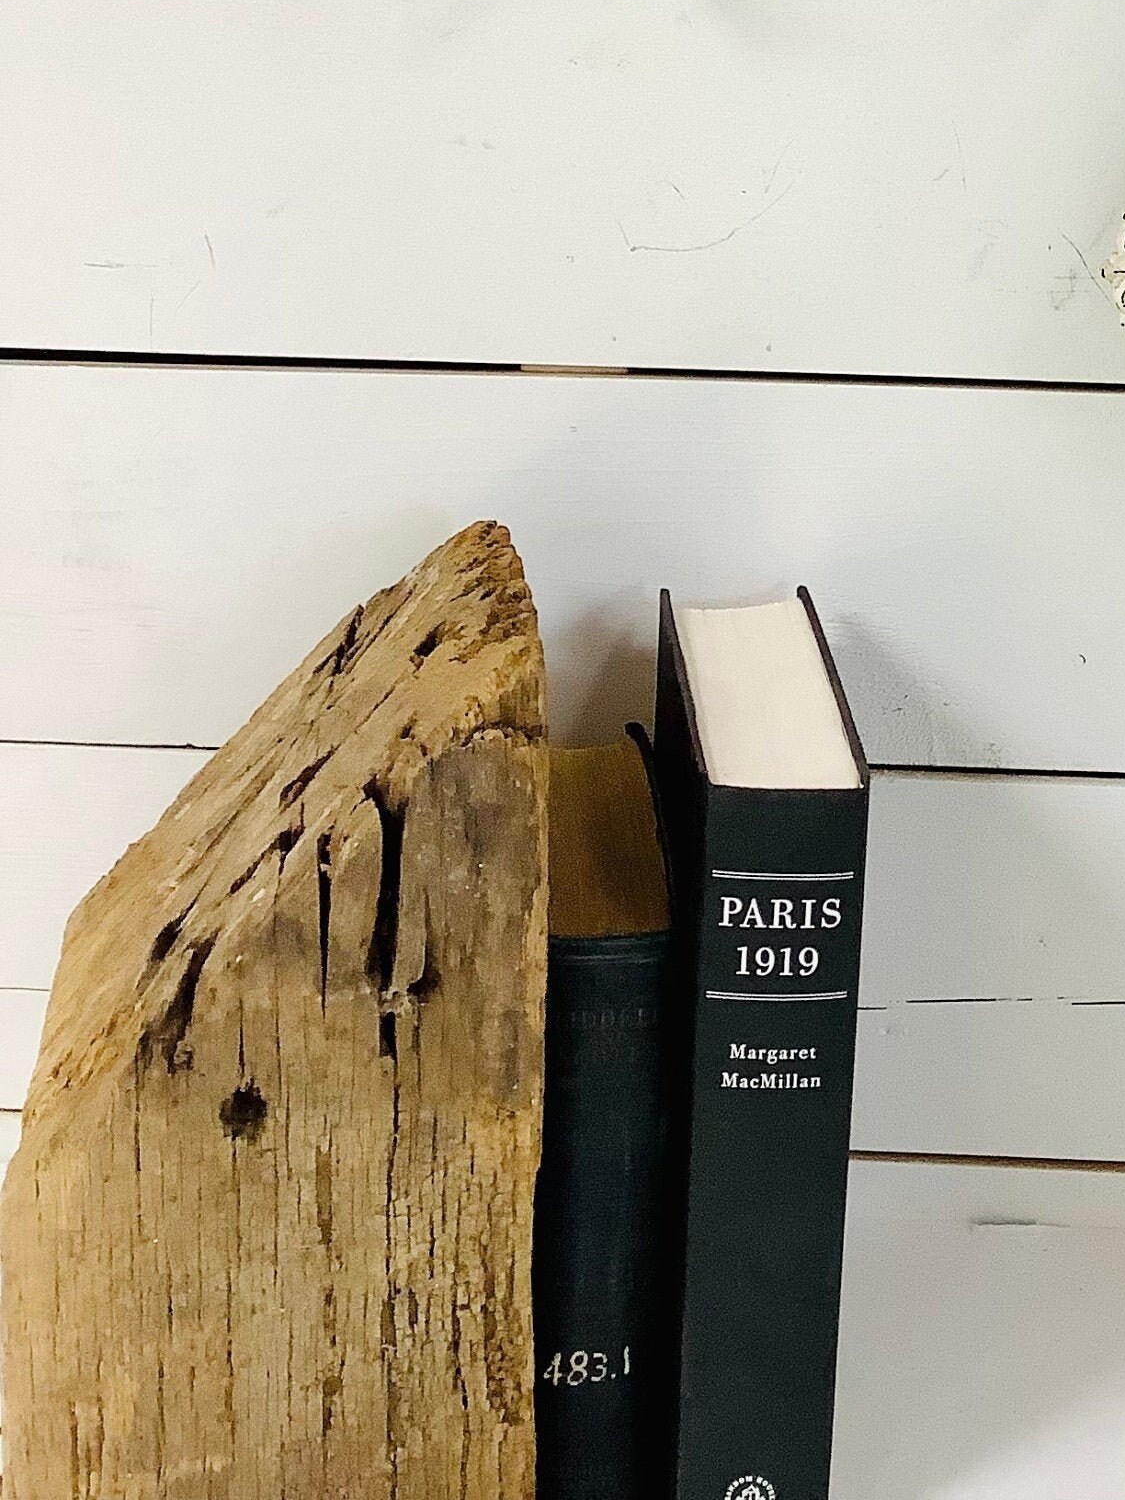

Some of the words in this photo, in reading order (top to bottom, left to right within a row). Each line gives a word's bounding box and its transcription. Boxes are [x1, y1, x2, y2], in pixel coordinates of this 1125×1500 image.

[718, 896, 842, 929] PARIS
[735, 946, 819, 977] 1919
[729, 1043, 817, 1064] Margaret
[720, 1071, 821, 1089] MacMillan
[543, 1346, 630, 1386] 483.1
